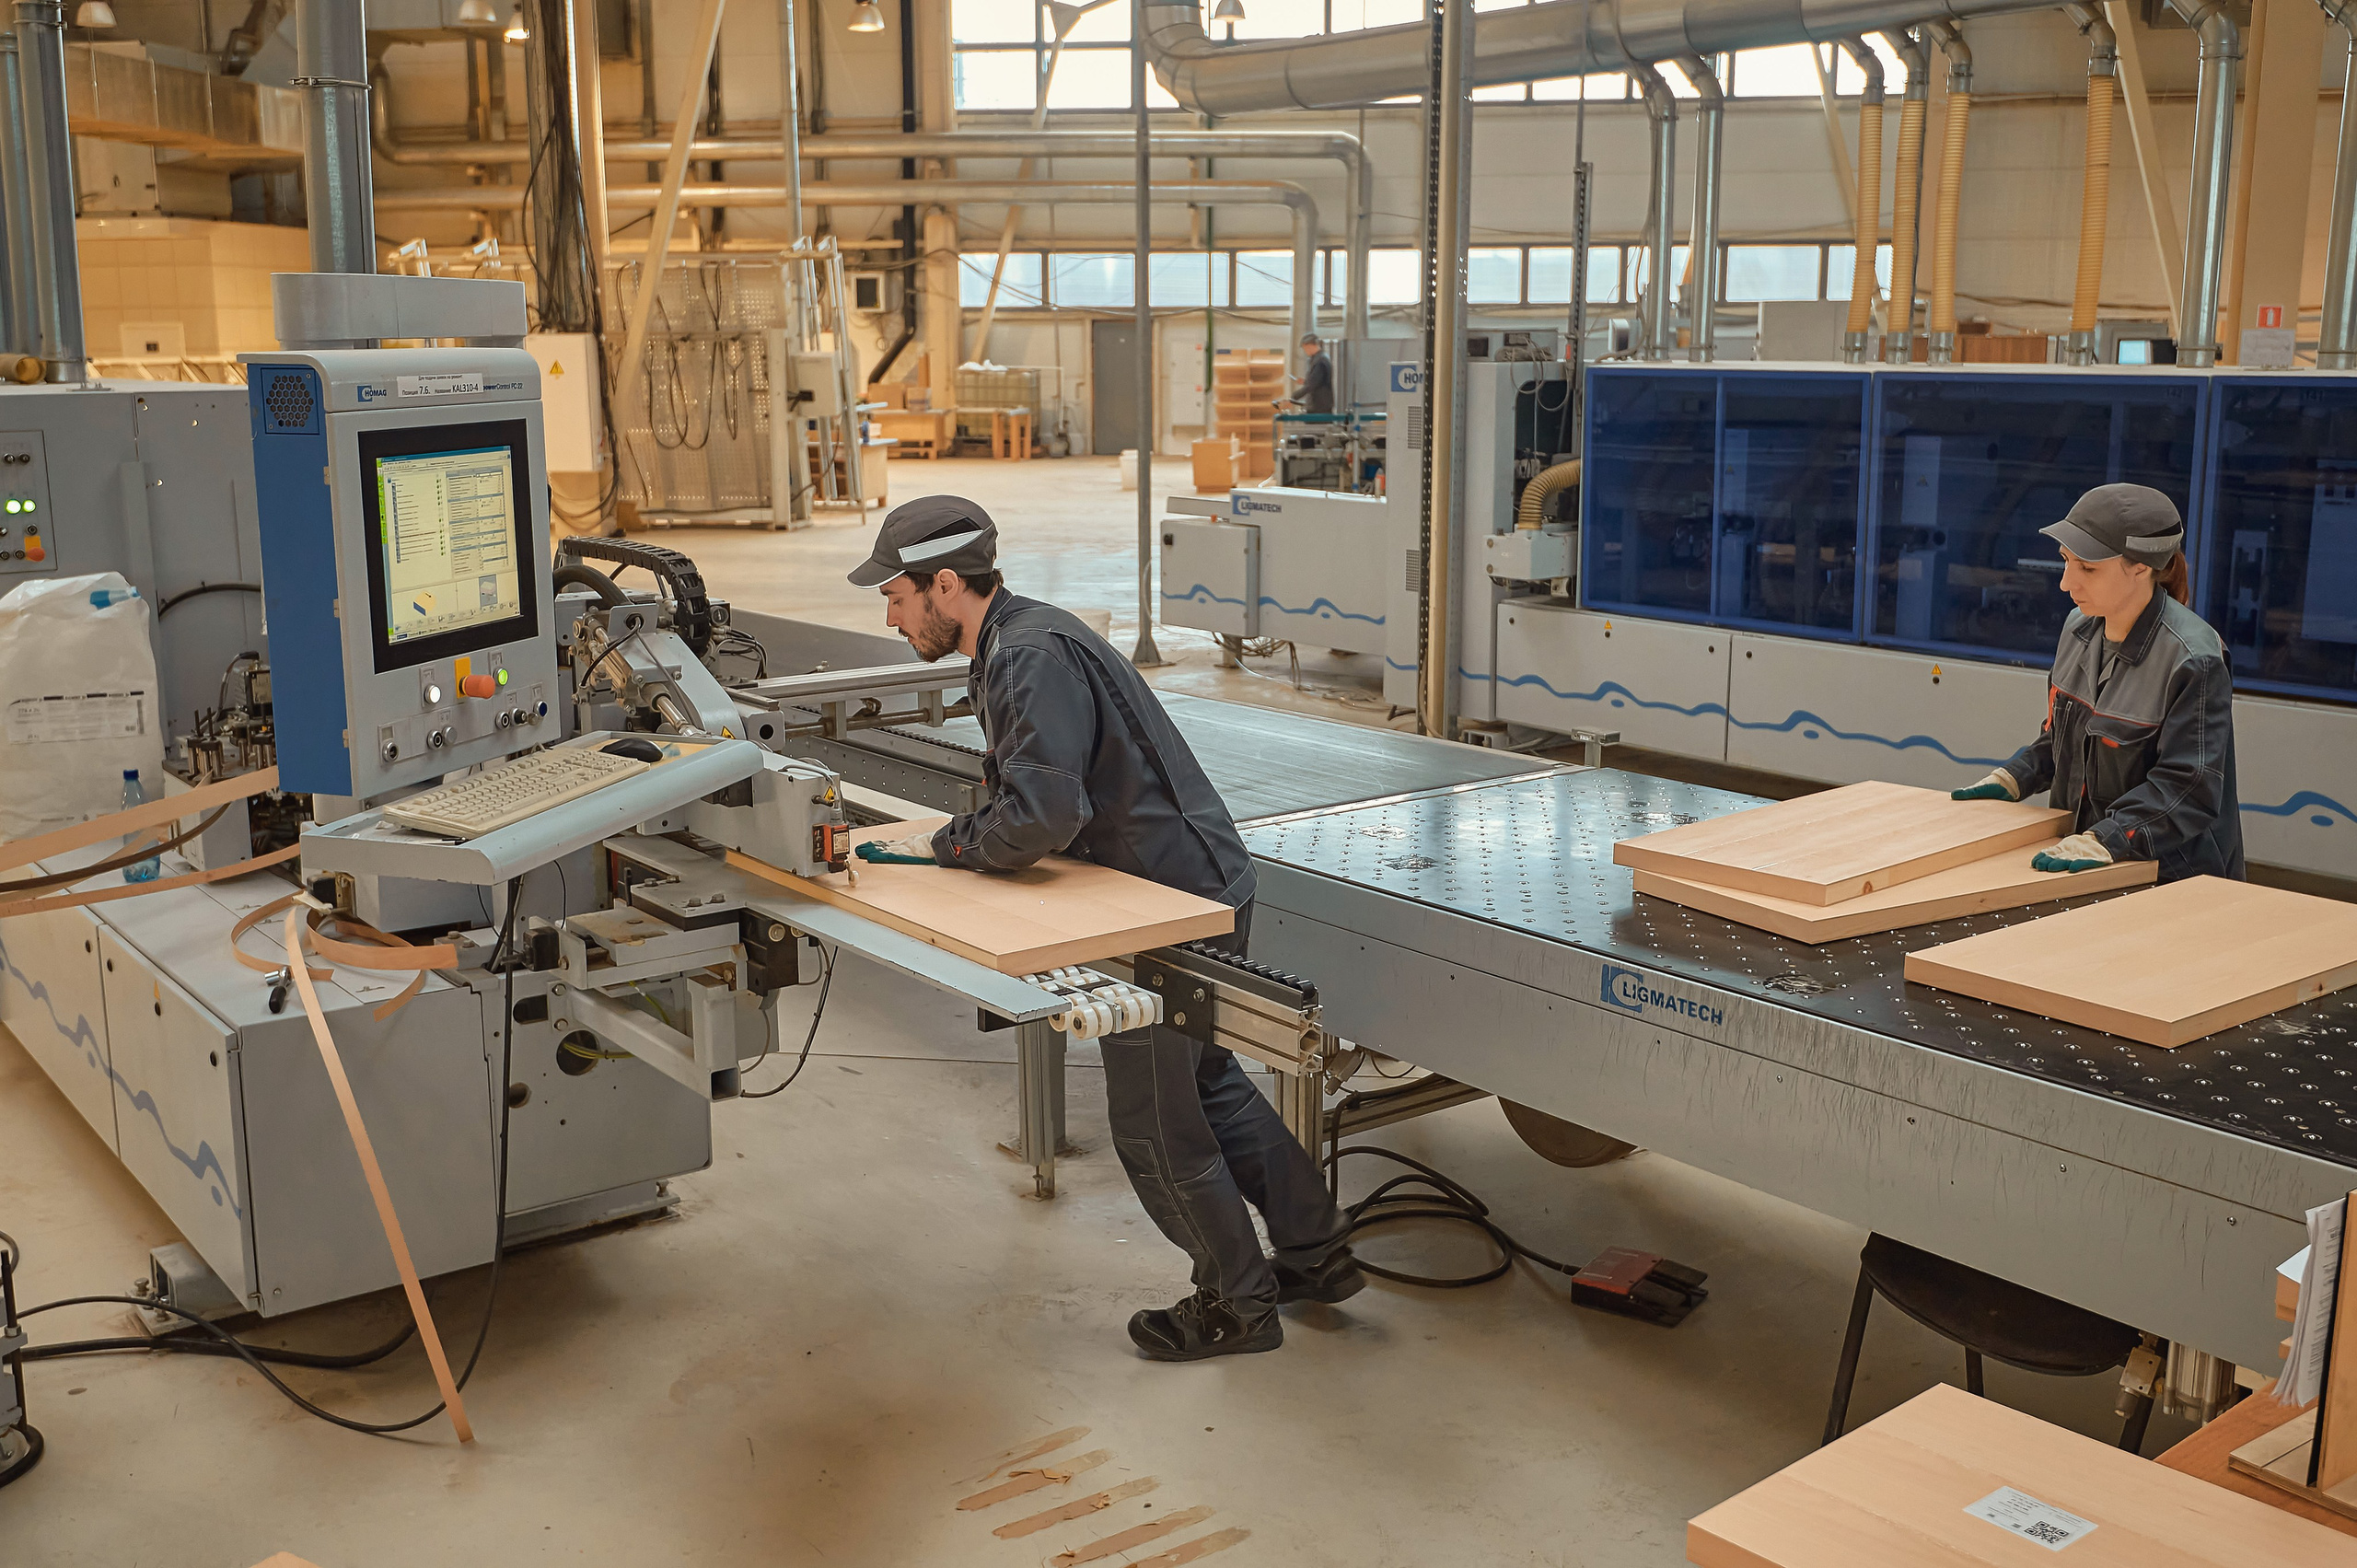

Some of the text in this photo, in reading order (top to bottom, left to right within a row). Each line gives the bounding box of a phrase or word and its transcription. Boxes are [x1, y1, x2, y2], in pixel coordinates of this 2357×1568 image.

[365, 389, 387, 397] HOMAG
[419, 386, 431, 395] 7.6.
[452, 383, 479, 392] KAL310-4
[1241, 501, 1282, 513] LIGMATECH
[1623, 981, 1723, 1026] LIGMATECH
